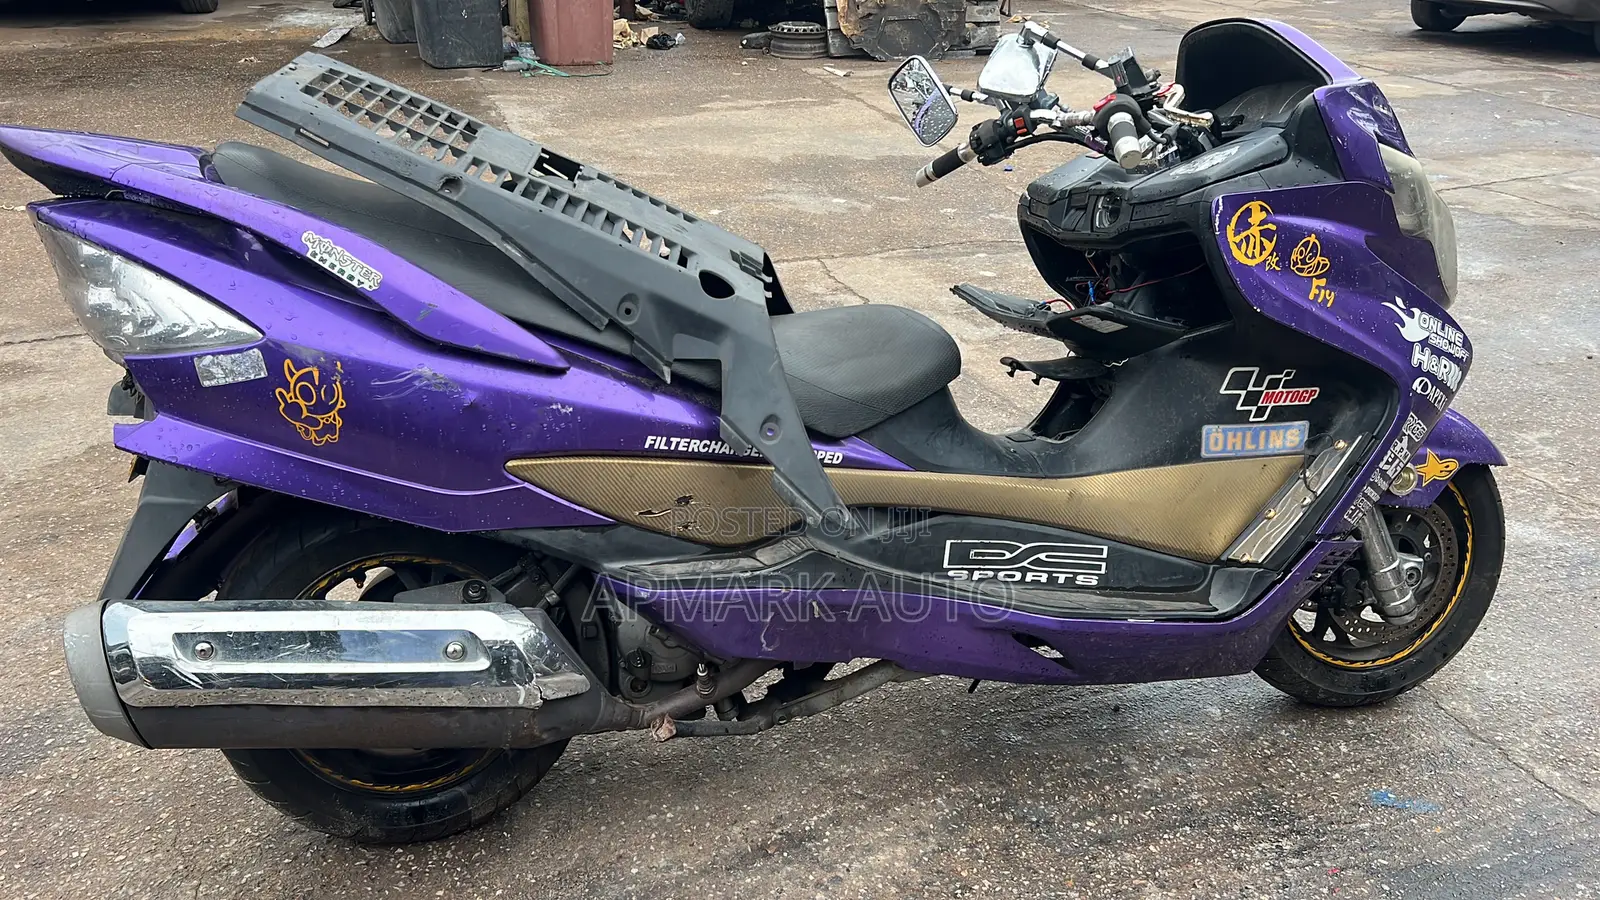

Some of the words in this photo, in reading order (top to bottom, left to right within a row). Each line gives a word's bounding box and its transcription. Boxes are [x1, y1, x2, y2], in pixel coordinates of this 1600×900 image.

[303, 232, 381, 288] MONSTER
[1308, 277, 1335, 308] Fly
[1419, 311, 1464, 347] ONLINE
[1260, 389, 1318, 405] MOTOGP
[1208, 427, 1301, 452] ÖHLINS
[943, 540, 1108, 574] DC
[947, 570, 1099, 586] SPORTS
